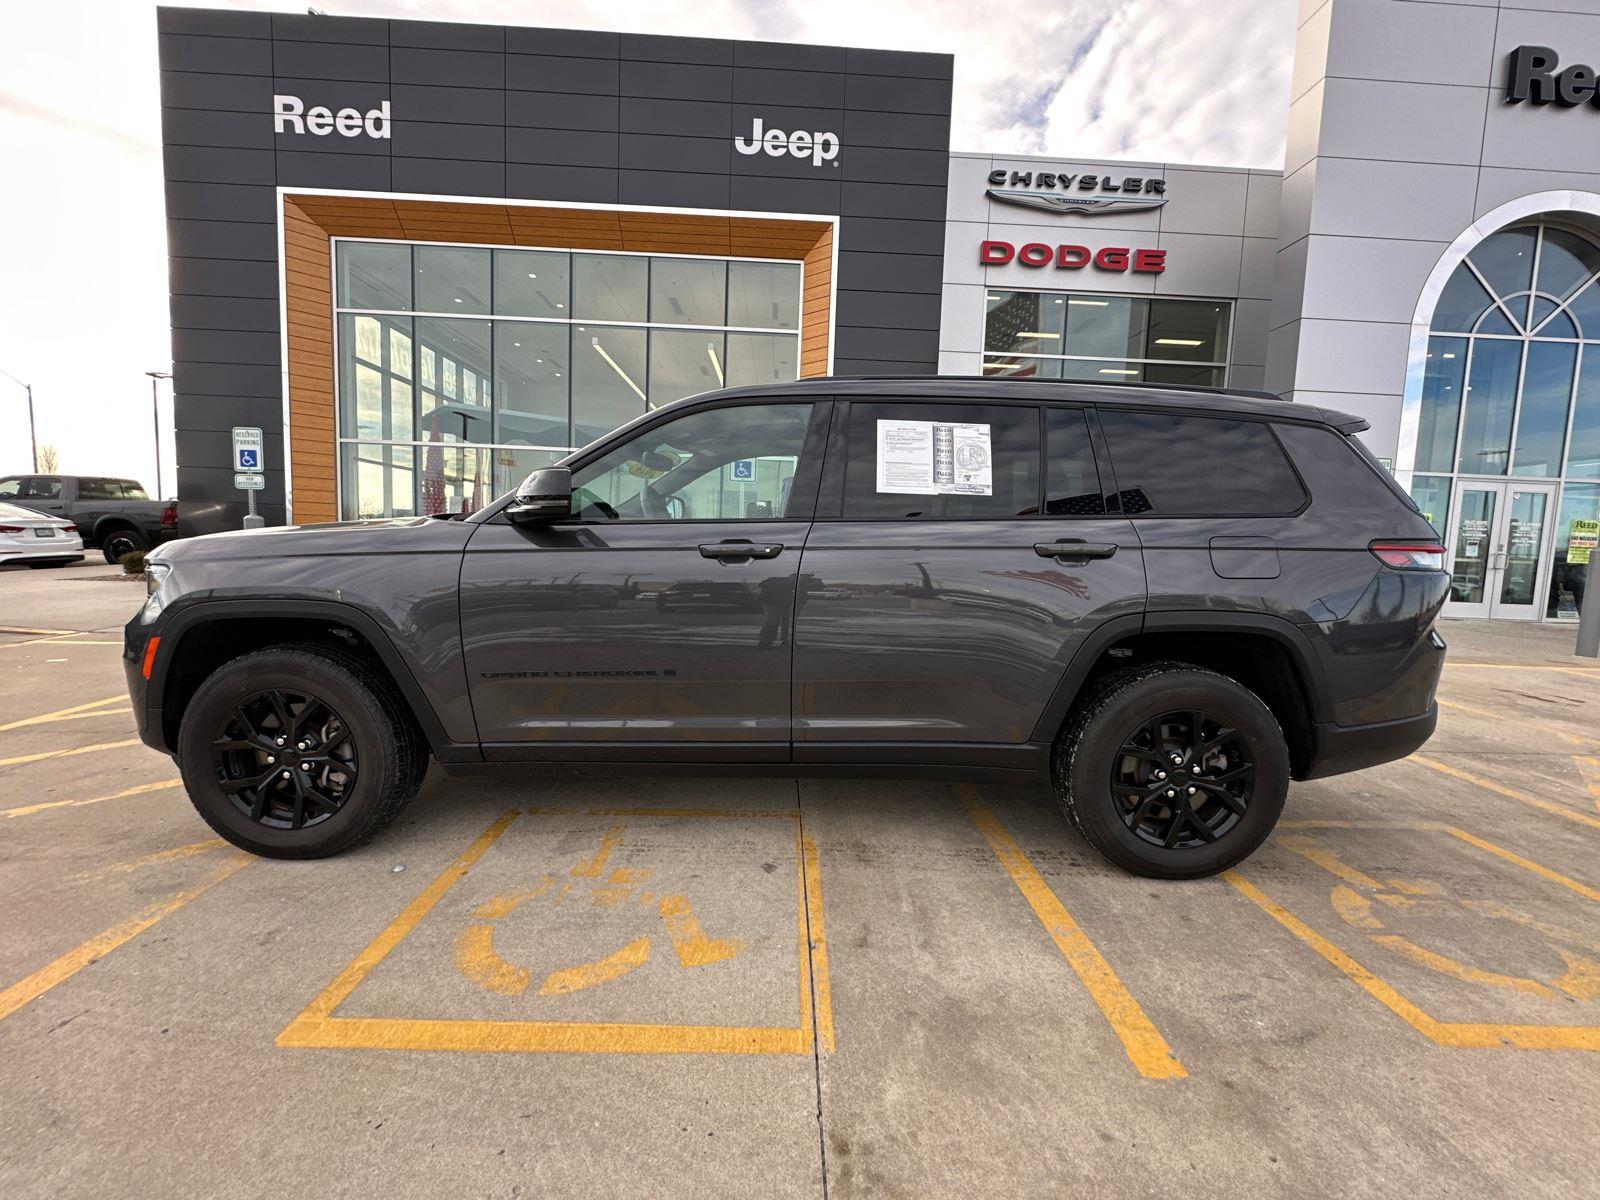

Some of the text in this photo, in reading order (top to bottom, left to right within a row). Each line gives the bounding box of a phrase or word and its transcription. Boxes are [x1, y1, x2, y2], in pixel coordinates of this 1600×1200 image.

[1506, 45, 1600, 107] Re
[273, 94, 391, 139] Reed
[734, 118, 840, 167] Jeep
[988, 169, 1166, 194] CHRYSLER
[980, 240, 1167, 274] DODGE
[236, 431, 260, 439] RESERVED
[481, 671, 549, 679] GRAND
[553, 670, 658, 678] CHEROKEE
